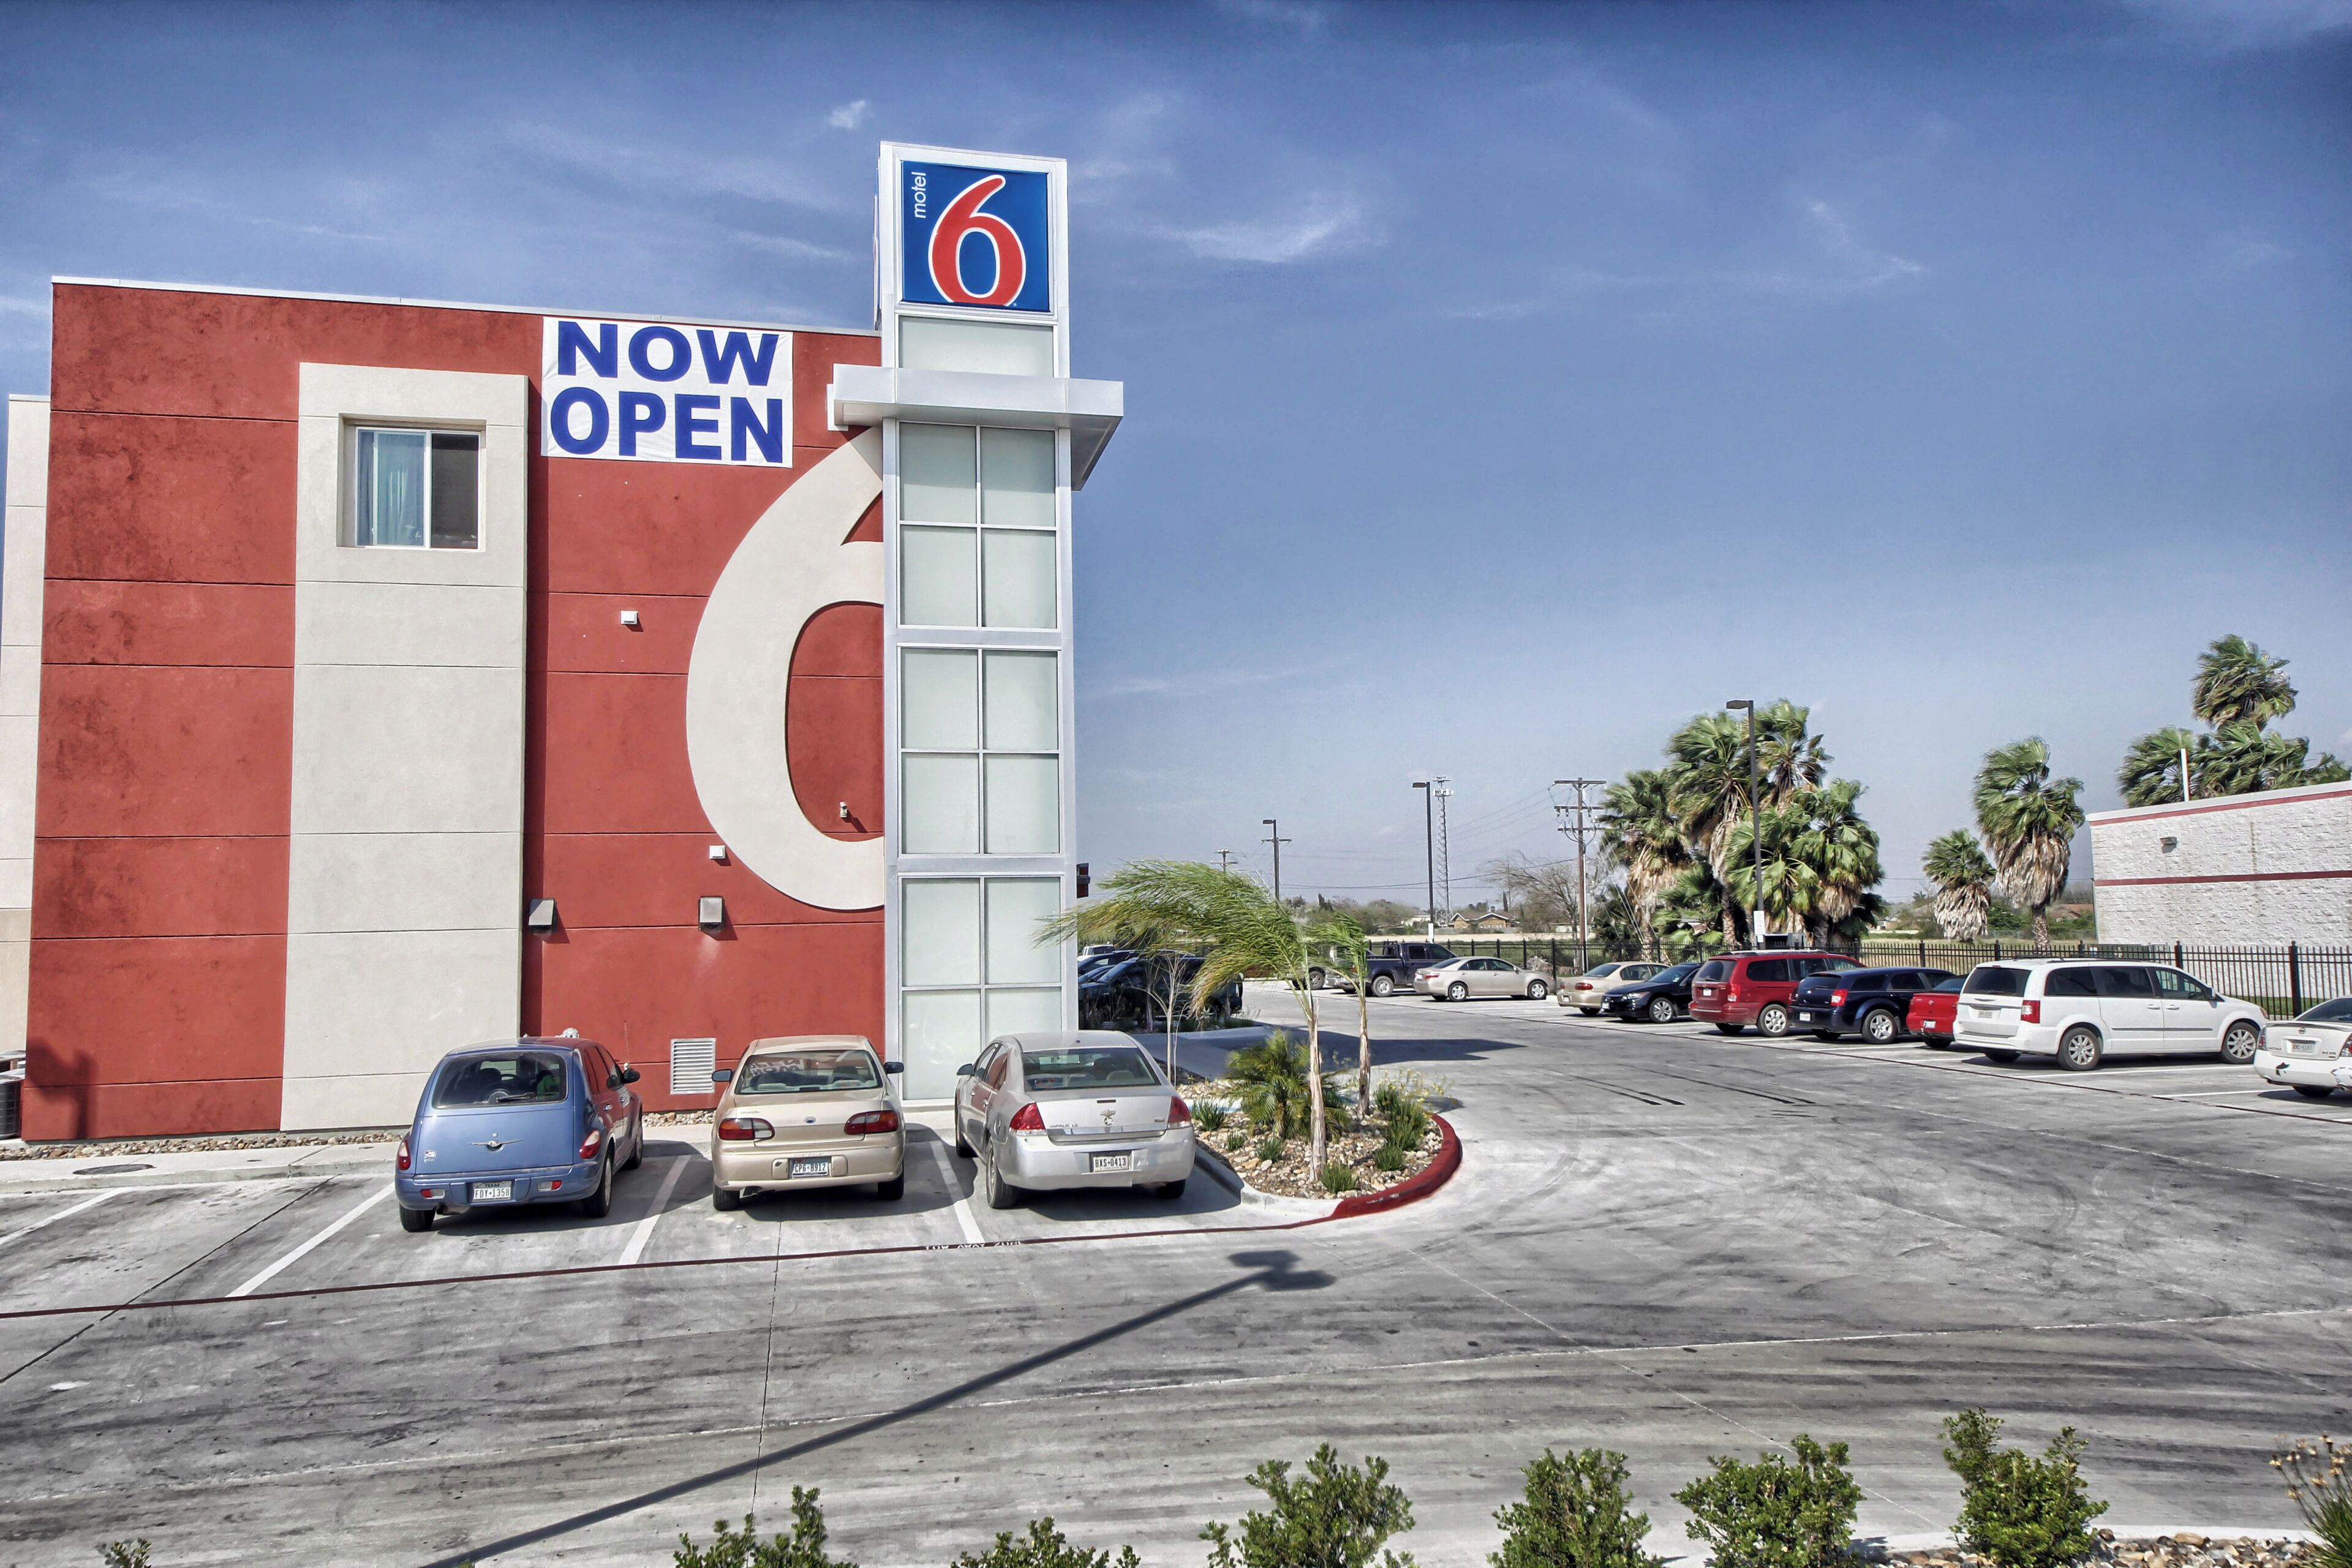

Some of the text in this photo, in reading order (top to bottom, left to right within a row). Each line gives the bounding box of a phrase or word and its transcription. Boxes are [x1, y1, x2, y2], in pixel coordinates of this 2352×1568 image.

[911, 172, 926, 219] motel
[928, 175, 1027, 307] 6
[557, 320, 779, 386] NOW
[550, 386, 783, 463] OPEN
